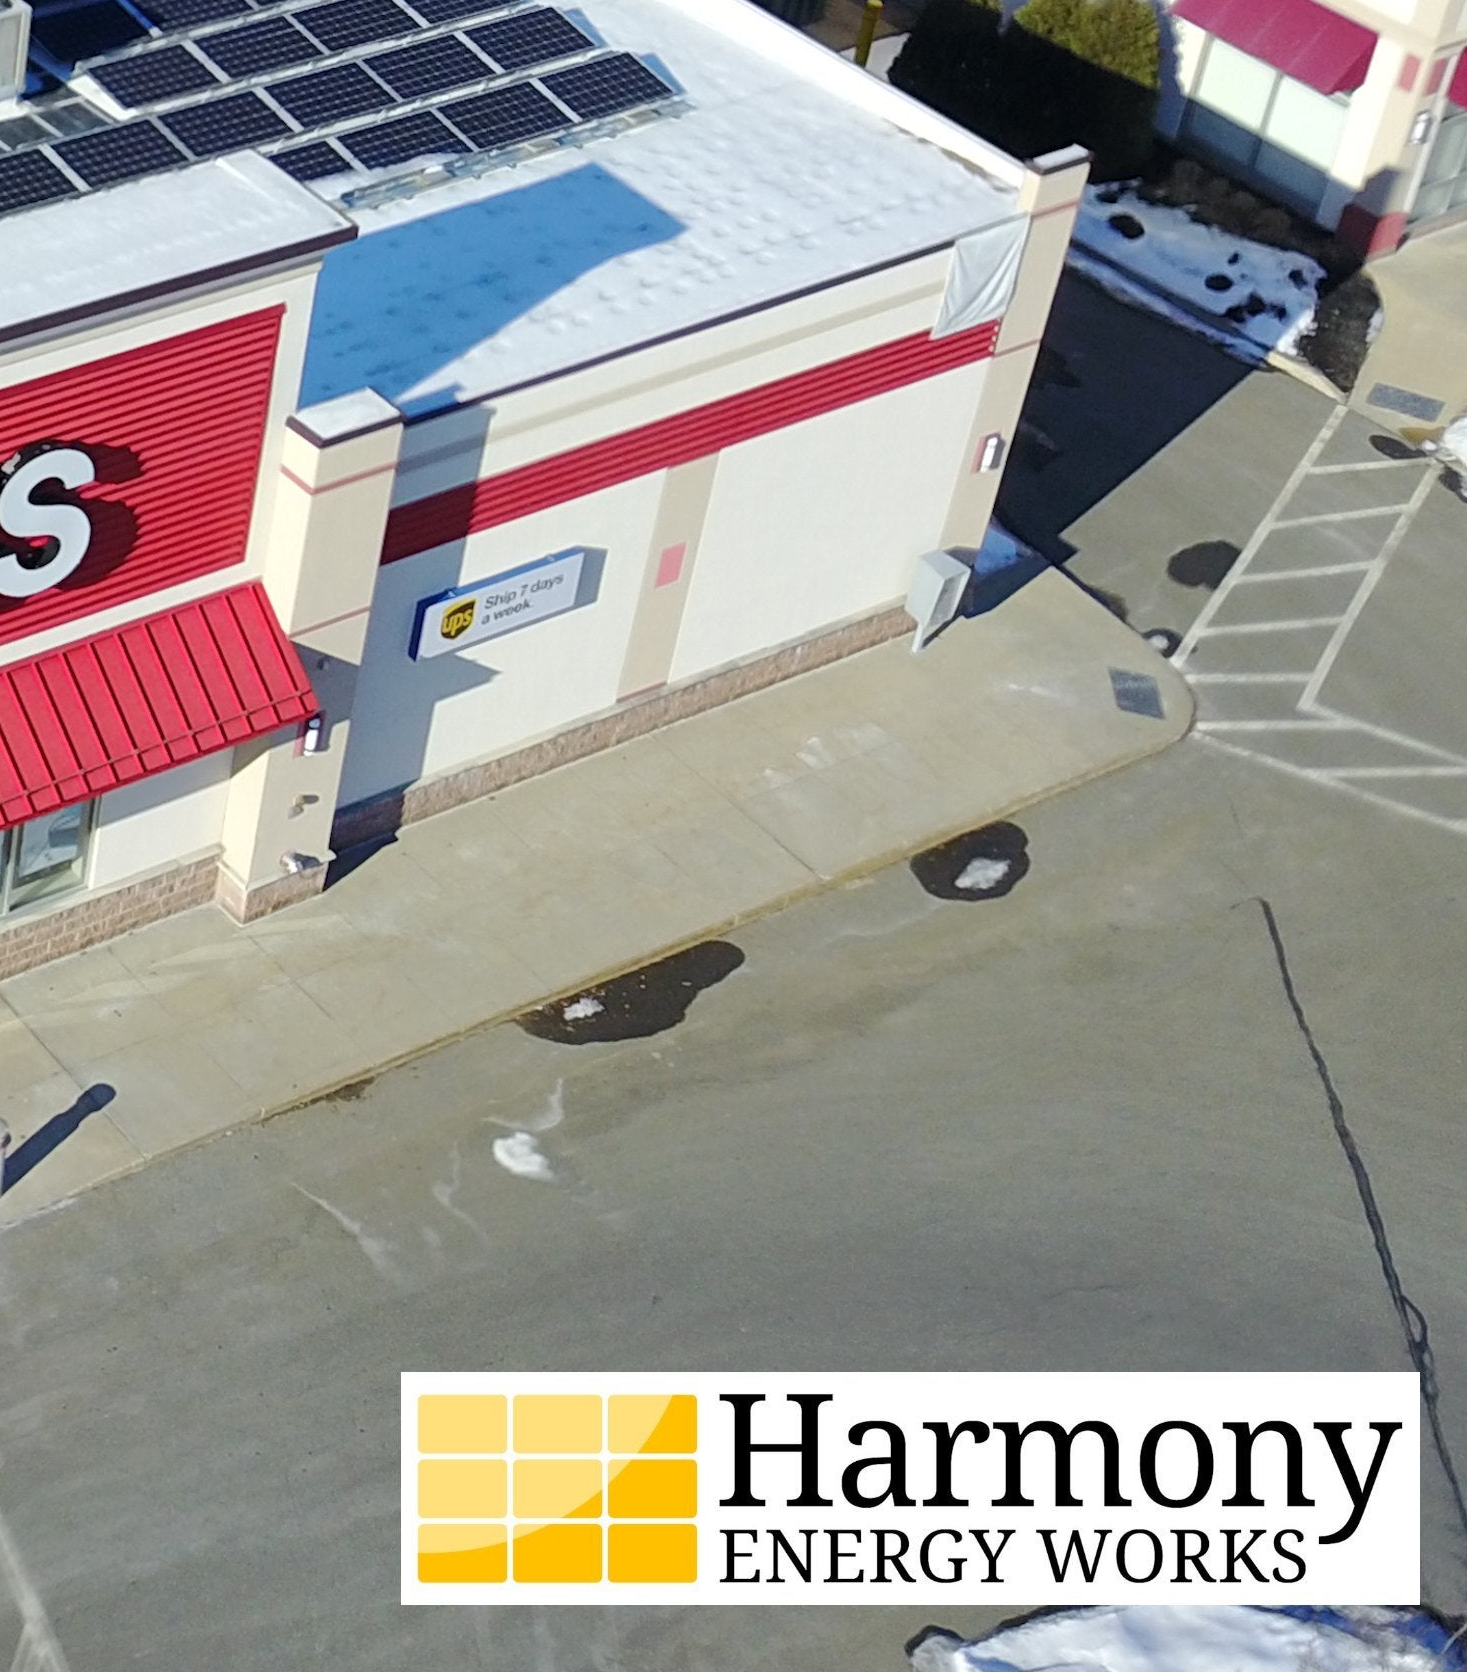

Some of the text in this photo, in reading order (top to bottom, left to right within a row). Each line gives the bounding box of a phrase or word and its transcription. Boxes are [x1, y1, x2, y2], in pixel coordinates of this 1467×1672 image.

[484, 574, 564, 610] Ship 7 days
[481, 599, 531, 625] a week
